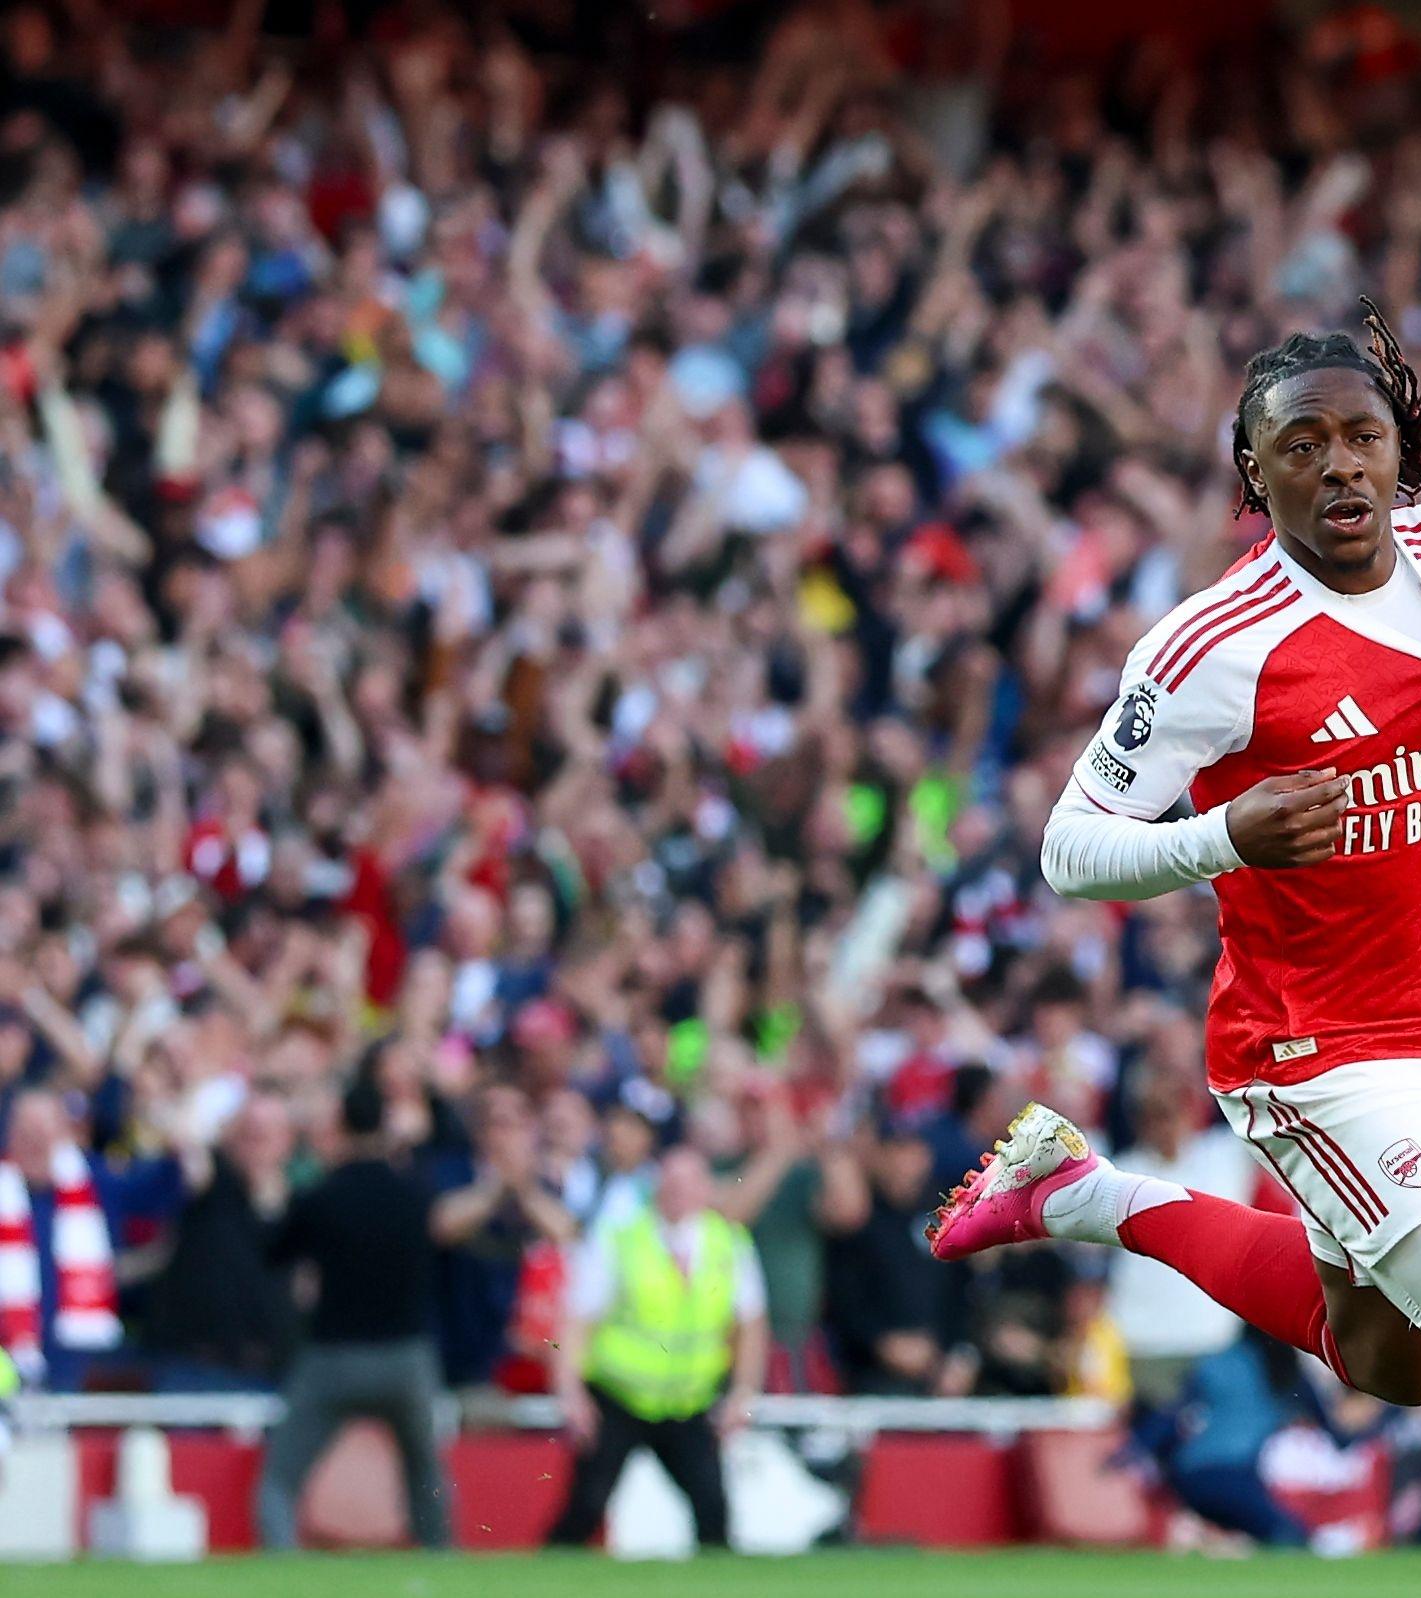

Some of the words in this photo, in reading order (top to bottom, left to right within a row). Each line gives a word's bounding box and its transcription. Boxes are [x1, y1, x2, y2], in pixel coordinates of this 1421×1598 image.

[1100, 748, 1130, 780] room
[1343, 809, 1395, 856] FLY
[1386, 1144, 1414, 1169] Arsenal
